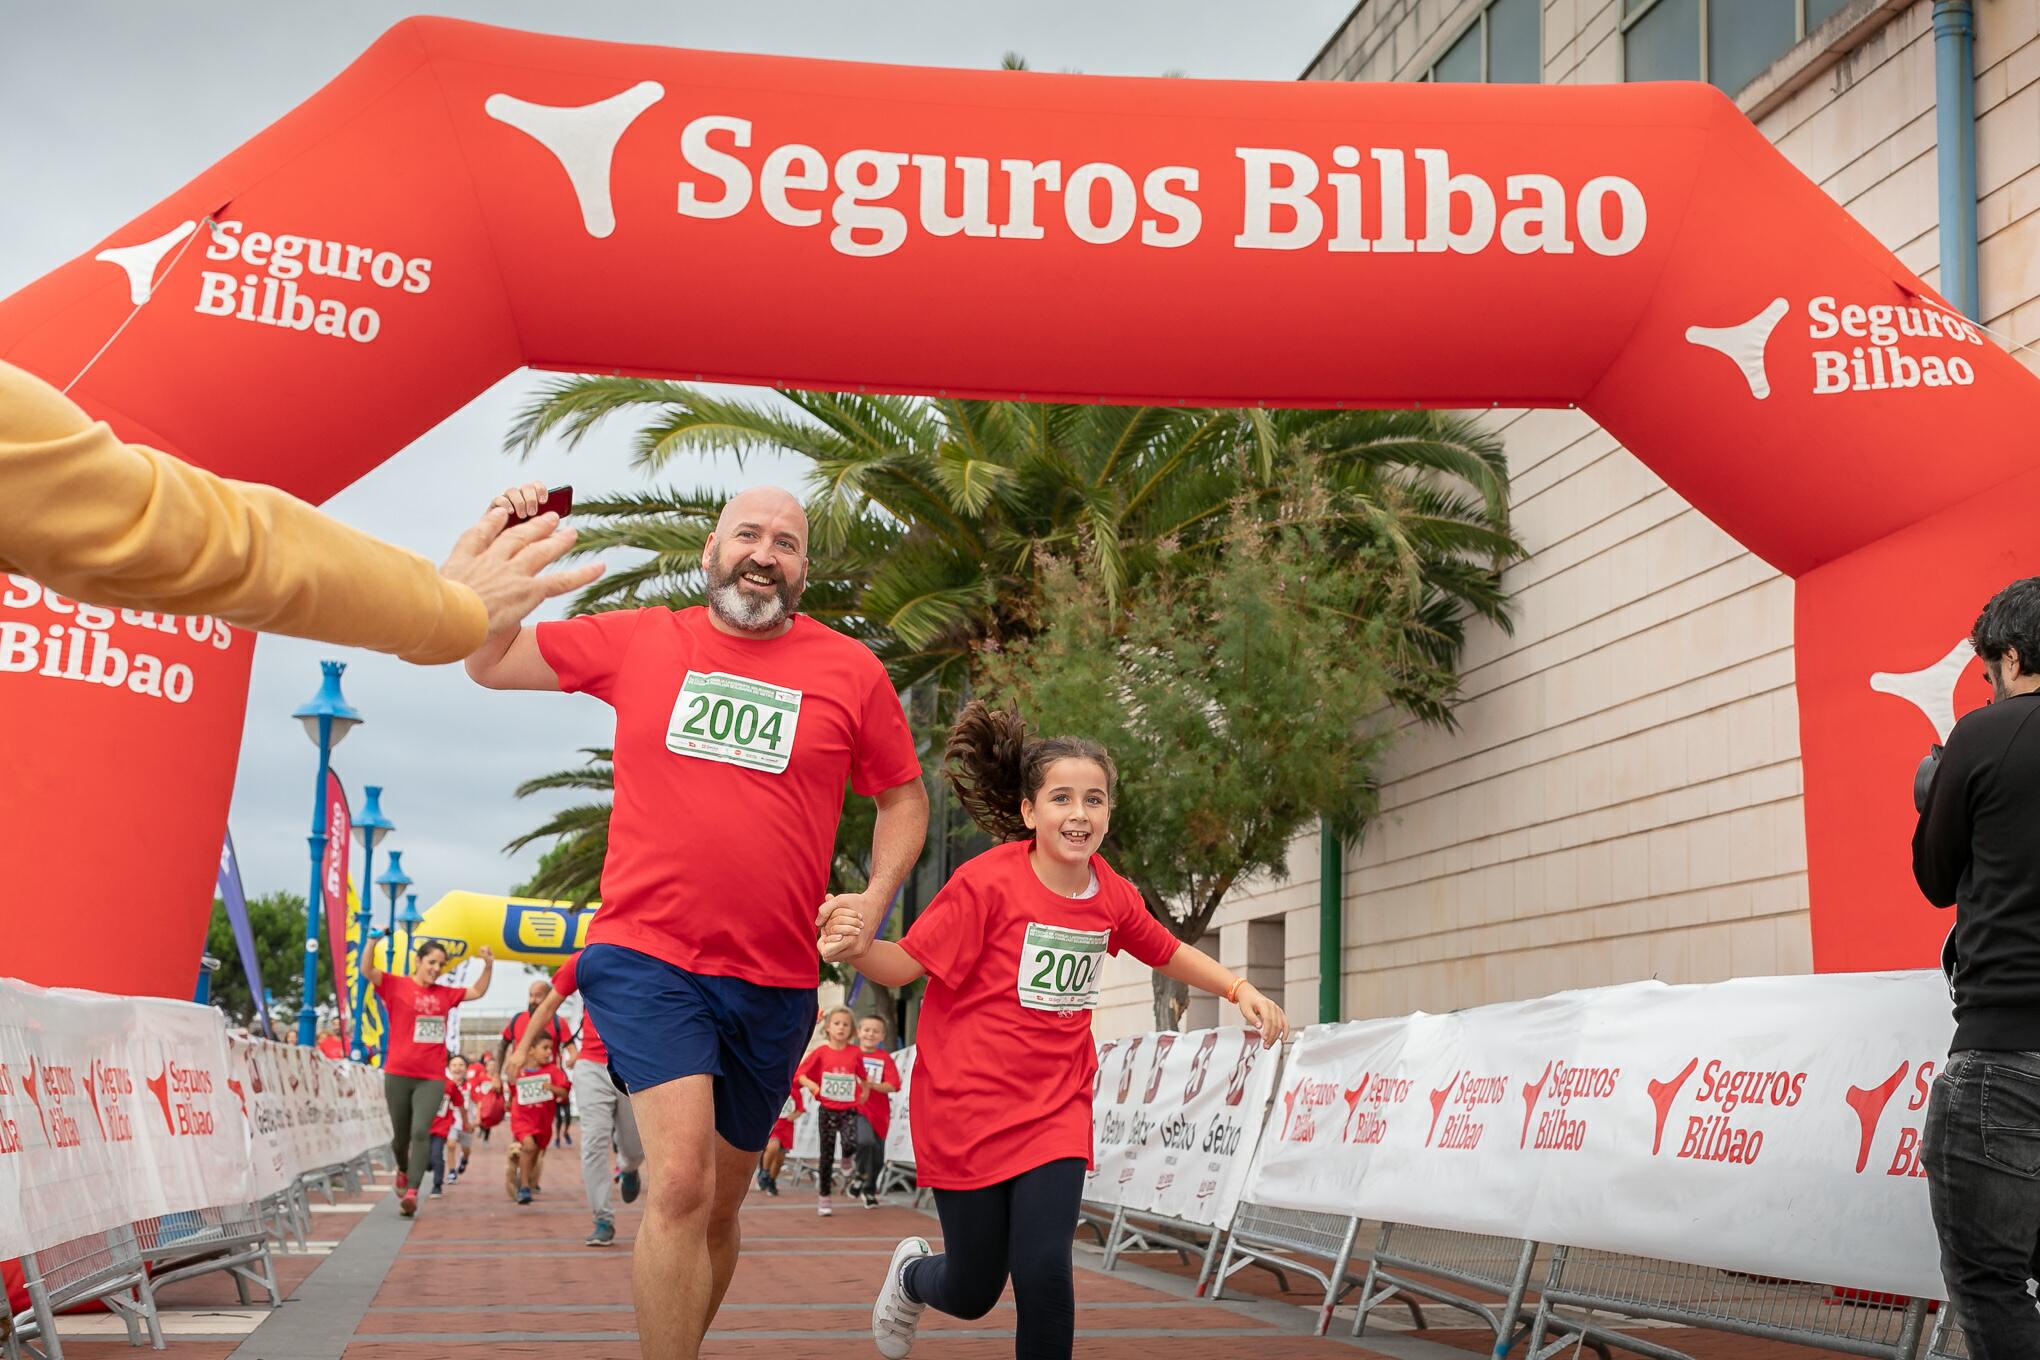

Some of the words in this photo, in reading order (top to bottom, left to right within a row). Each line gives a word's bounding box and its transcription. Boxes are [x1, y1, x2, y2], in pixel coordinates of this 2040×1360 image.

[677, 115, 1202, 258] Seguros
[1233, 145, 1647, 257] Bilbao
[206, 220, 432, 293] Seguros
[194, 271, 381, 343] Bilbao
[1807, 295, 1984, 346] Seguros
[1811, 346, 1975, 395] Bilbao
[0, 621, 194, 704] Bilbao
[682, 695, 783, 751] 2004
[1454, 1070, 1509, 1112] Seguros
[1547, 1059, 1622, 1107] Seguros
[1695, 1058, 1808, 1113] Seguros
[1160, 1111, 1198, 1151] Getxo
[1202, 1113, 1242, 1156] Getxo
[1352, 1111, 1388, 1144] Bilbao
[1438, 1114, 1485, 1150] Bilbao
[1533, 1110, 1588, 1151] Bilbao
[1676, 1115, 1764, 1166] Bilbao
